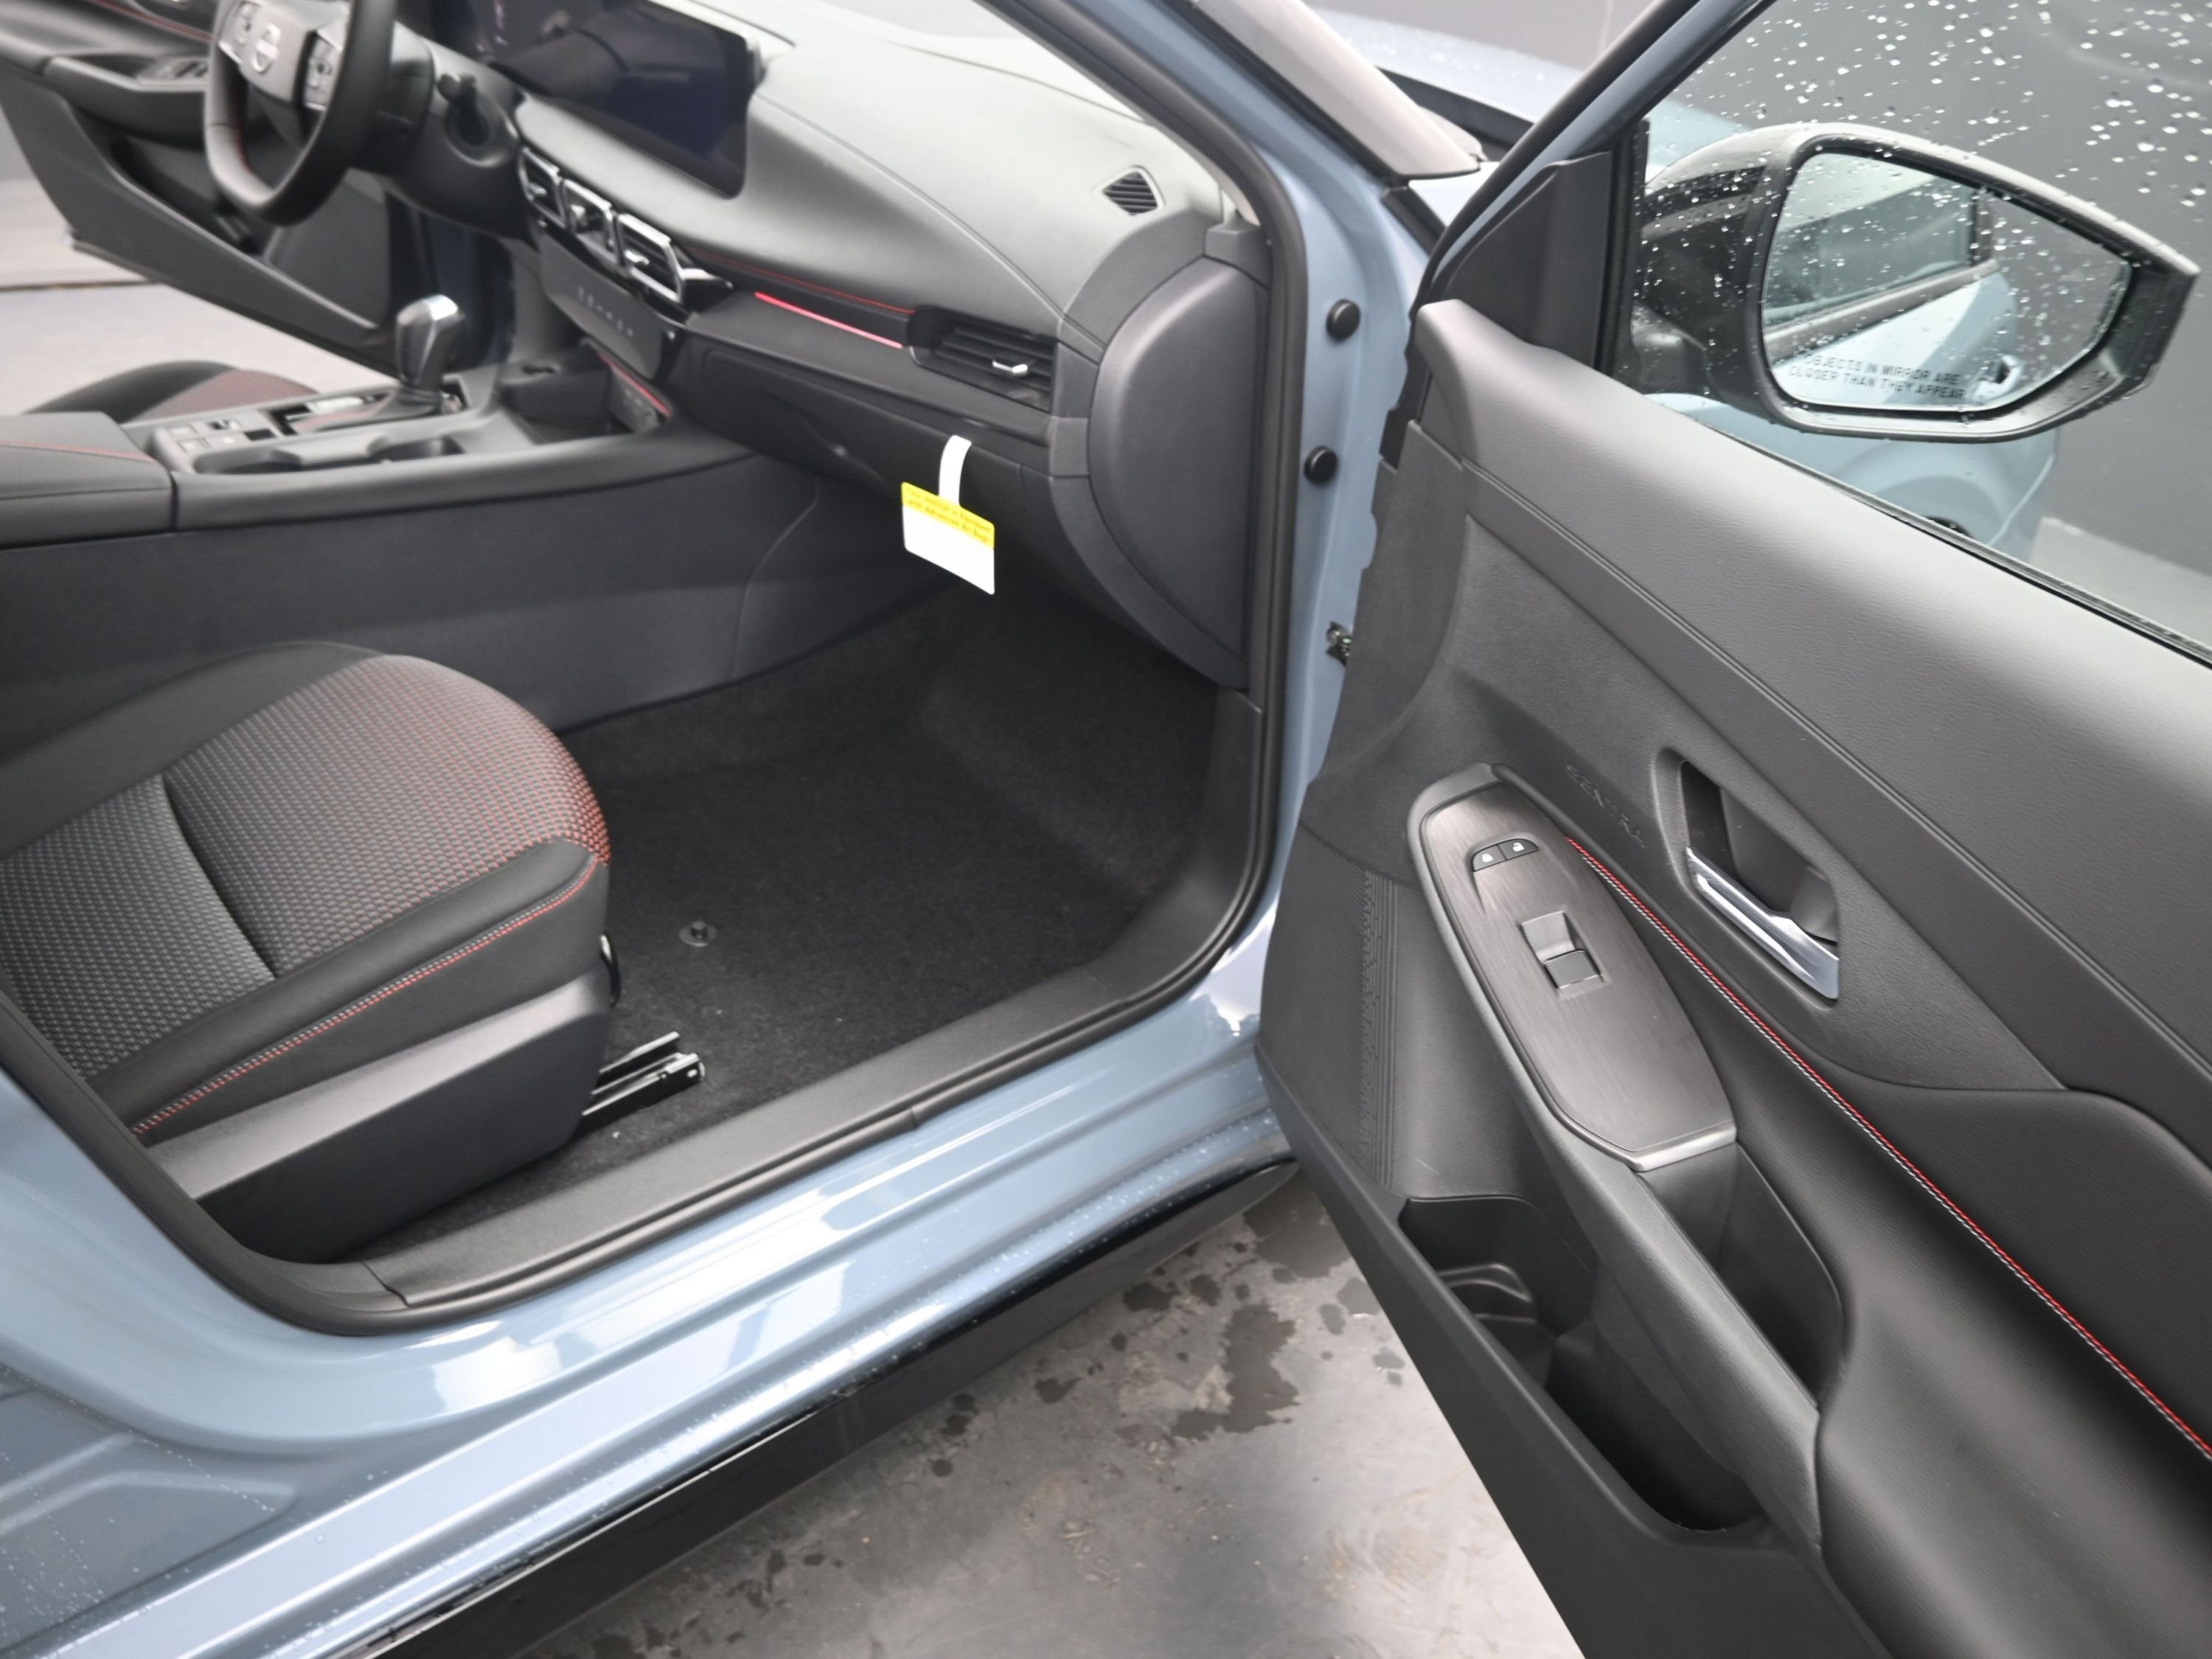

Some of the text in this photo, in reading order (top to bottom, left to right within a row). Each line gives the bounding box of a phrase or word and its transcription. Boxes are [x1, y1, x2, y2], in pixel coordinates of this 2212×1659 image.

[1789, 365, 1966, 399] CLOSER THAN THEY APPEAR
[1806, 354, 1961, 386] OBJECTS IN MIRROR ARE
